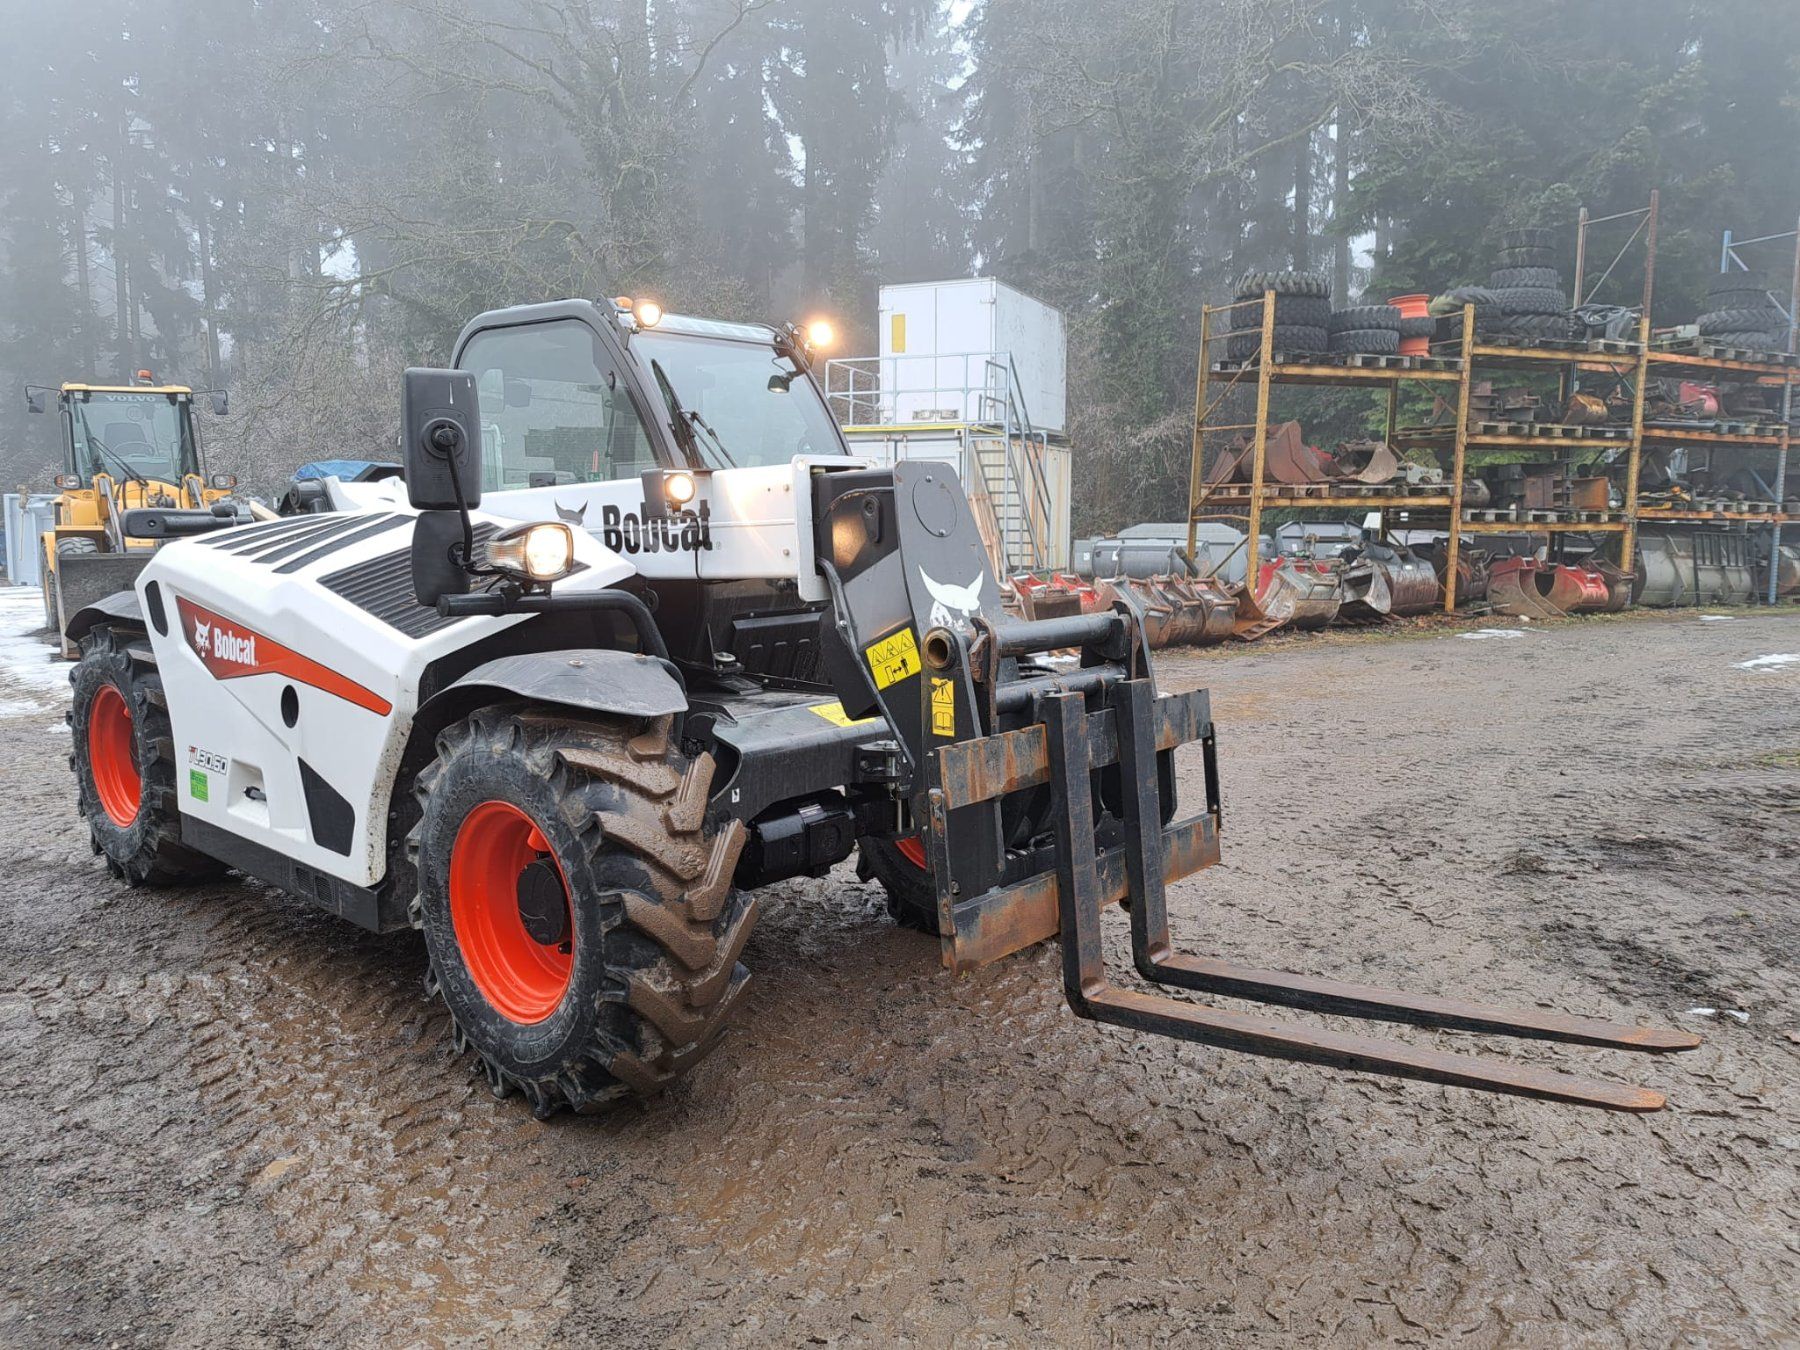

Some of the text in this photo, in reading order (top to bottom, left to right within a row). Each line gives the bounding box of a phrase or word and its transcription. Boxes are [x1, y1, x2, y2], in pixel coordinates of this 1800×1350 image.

[106, 394, 156, 402] VOLVO
[602, 499, 713, 555] Bobcat
[213, 627, 257, 667] Bobcat
